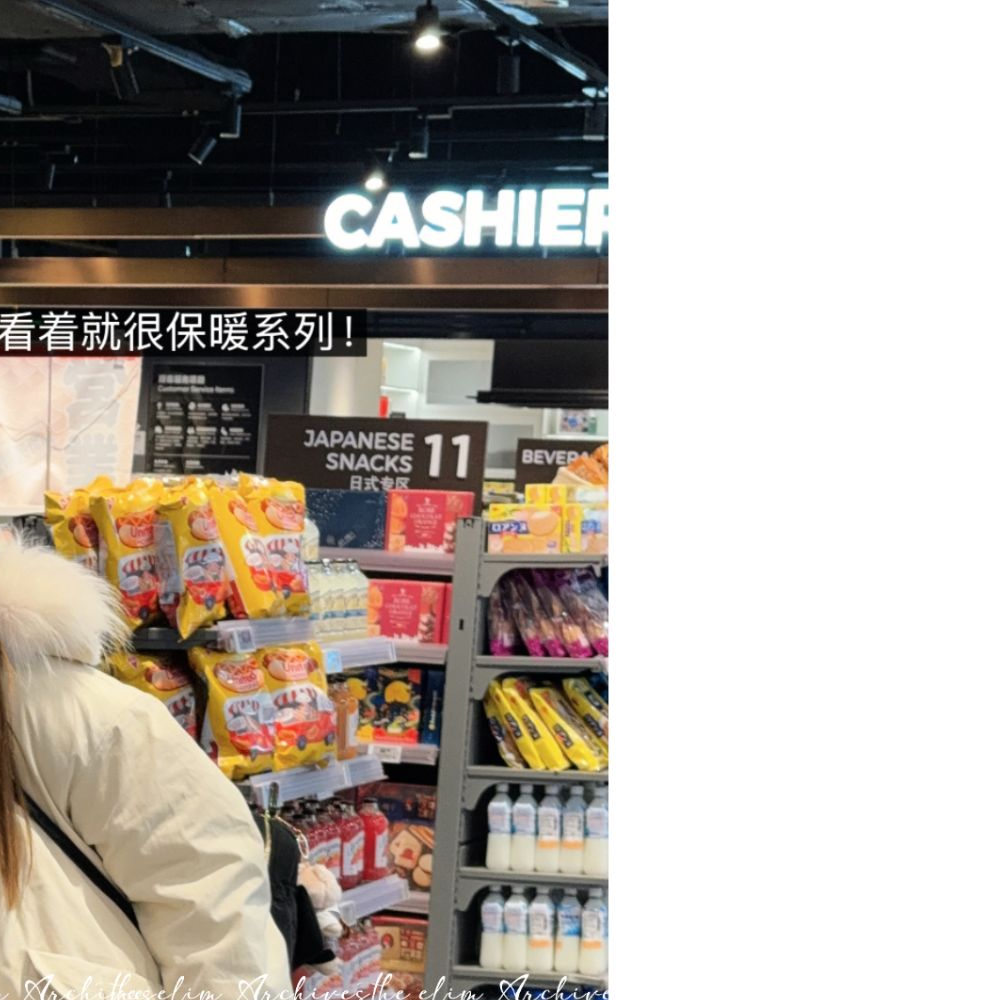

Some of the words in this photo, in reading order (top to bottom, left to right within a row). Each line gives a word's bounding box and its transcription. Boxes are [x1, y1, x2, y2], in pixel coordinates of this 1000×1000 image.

[303, 429, 415, 451] JAPANESE
[325, 452, 414, 474] SNACKS
[424, 433, 471, 479] 11
